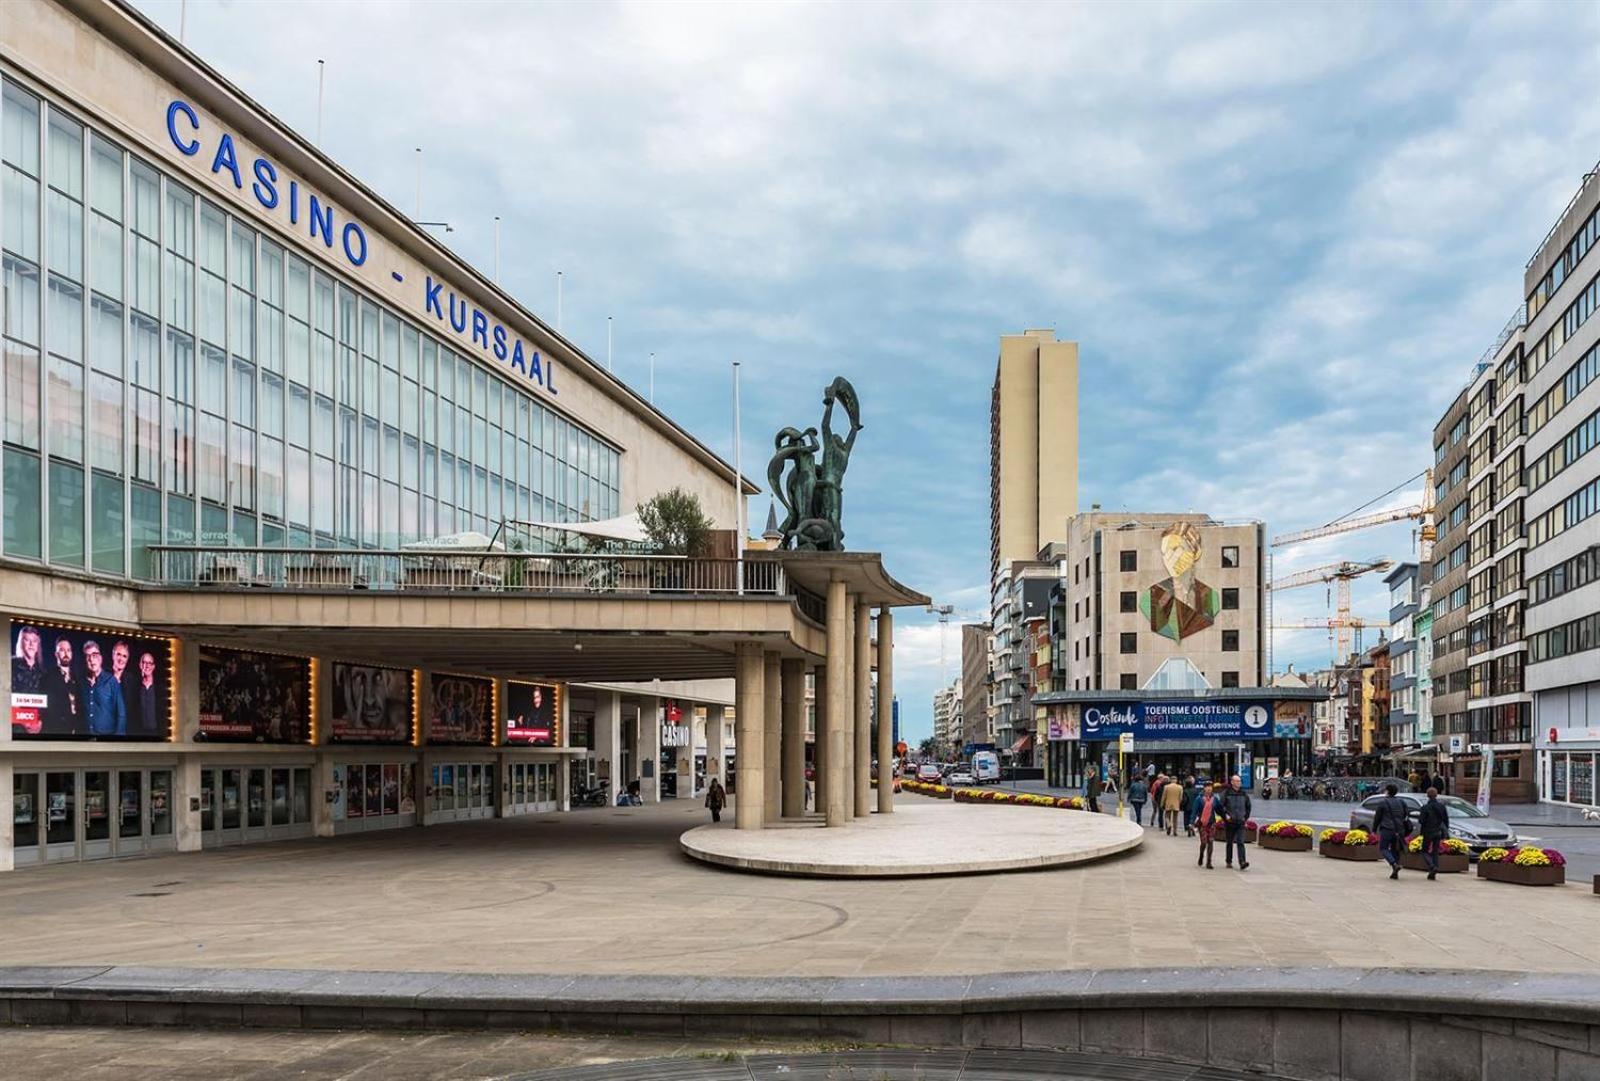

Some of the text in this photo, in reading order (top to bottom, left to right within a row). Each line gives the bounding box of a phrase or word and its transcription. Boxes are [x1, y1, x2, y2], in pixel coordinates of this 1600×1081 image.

[166, 100, 367, 266] CASINO
[426, 276, 557, 395] KURSAAL
[604, 540, 664, 550] The Terrace
[1145, 705, 1241, 715] TOERISME OOSTENDE
[1145, 714, 1164, 723] INFO
[1208, 722, 1240, 730] OOSTENDE
[662, 725, 689, 746] CASINO
